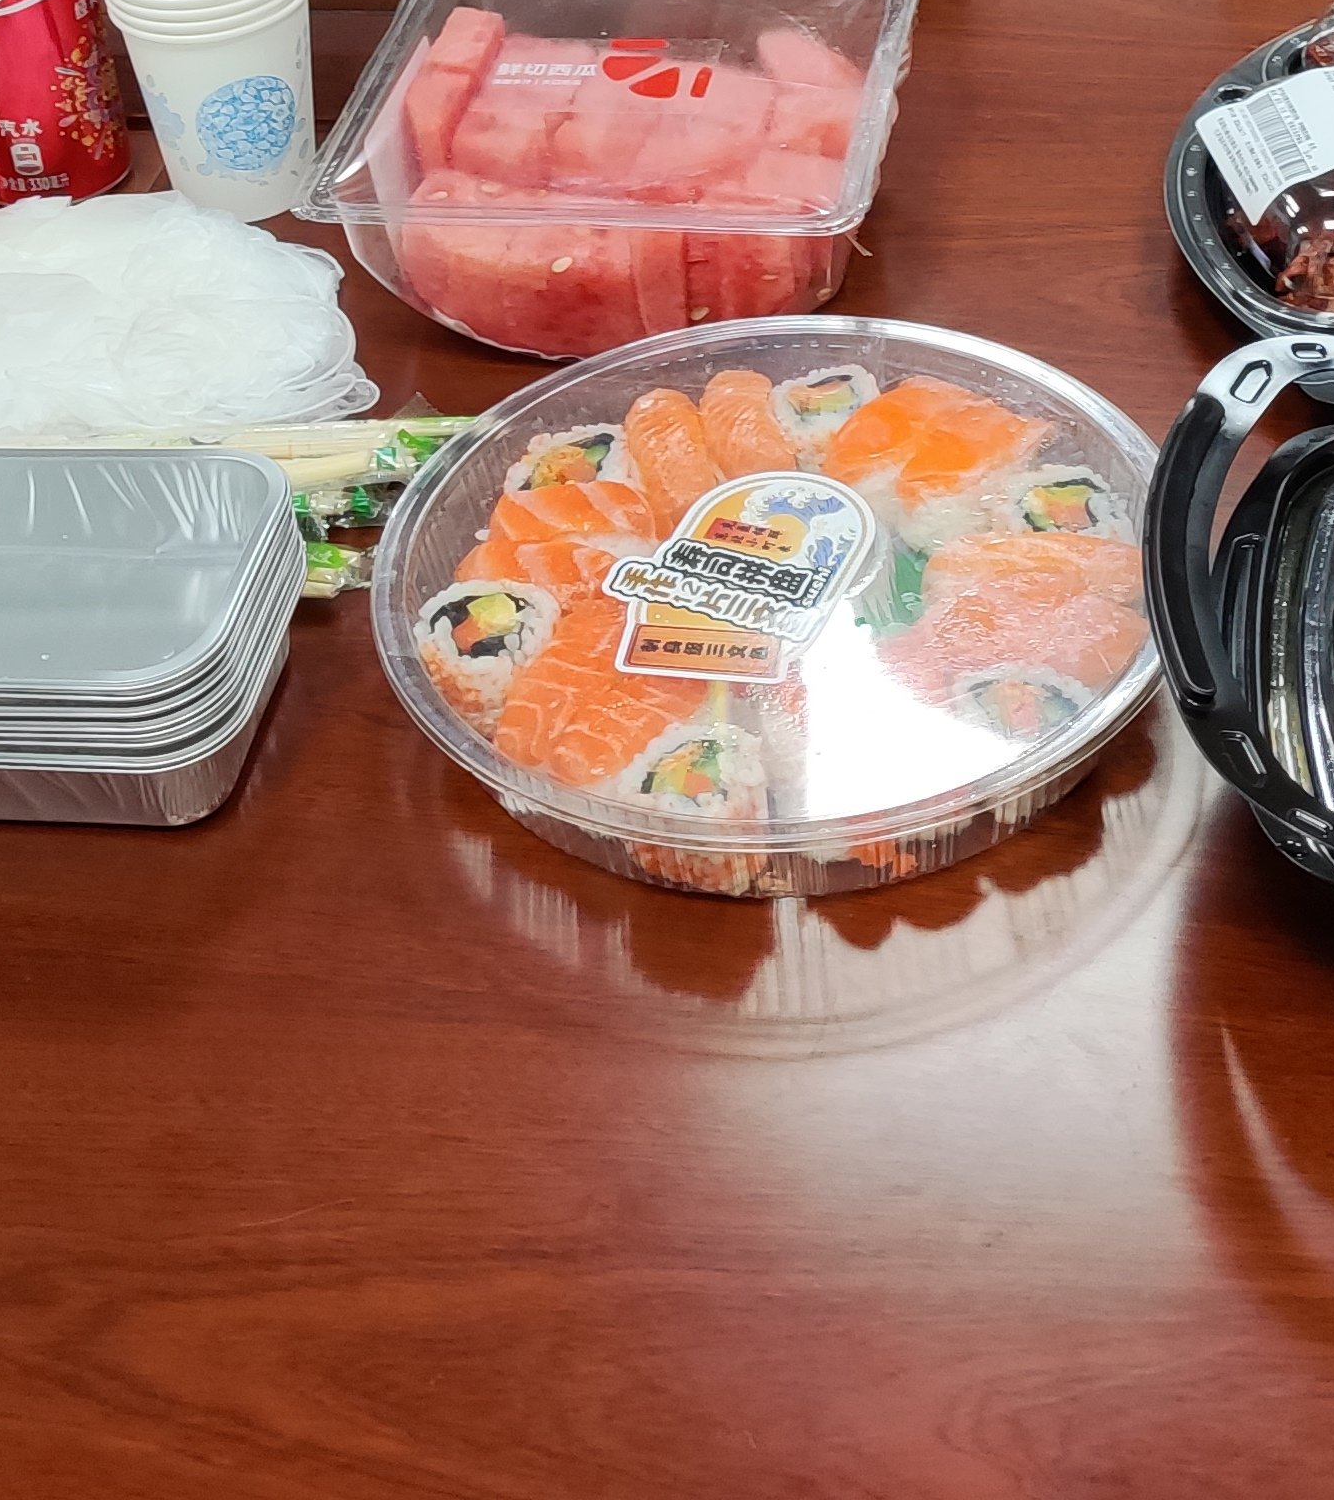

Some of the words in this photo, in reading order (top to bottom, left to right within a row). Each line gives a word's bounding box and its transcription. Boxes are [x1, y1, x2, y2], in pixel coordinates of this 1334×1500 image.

[496, 62, 598, 78] 鲜切西瓜
[669, 540, 811, 598] 寿司拼盘
[801, 566, 833, 608] sushi
